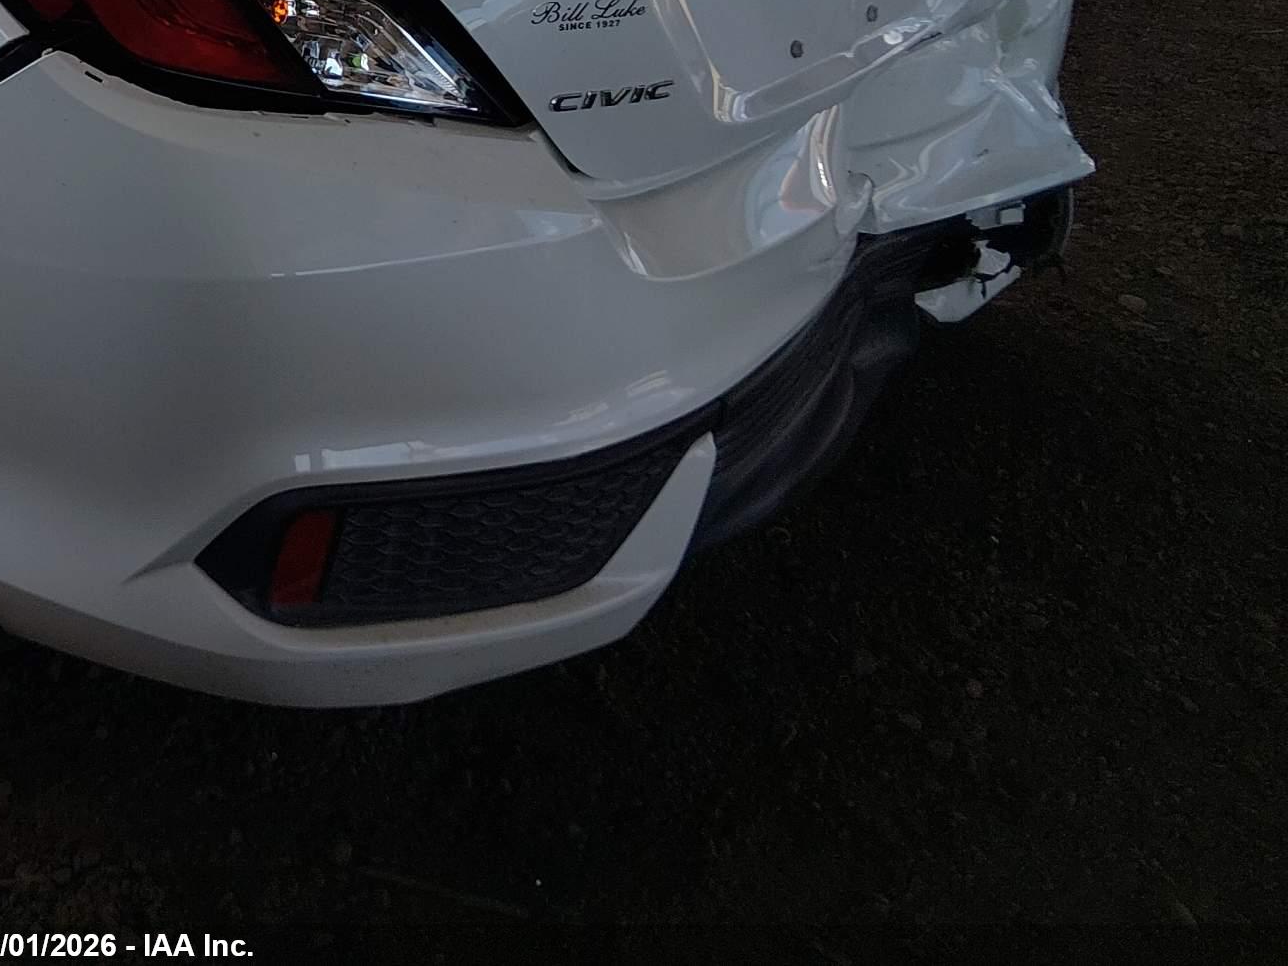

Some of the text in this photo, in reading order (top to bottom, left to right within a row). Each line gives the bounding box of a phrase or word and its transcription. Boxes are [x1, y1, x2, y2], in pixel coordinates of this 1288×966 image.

[531, 1, 590, 25] Bill
[559, 19, 621, 31] SINCE 1927
[548, 79, 675, 112] CIVIC
